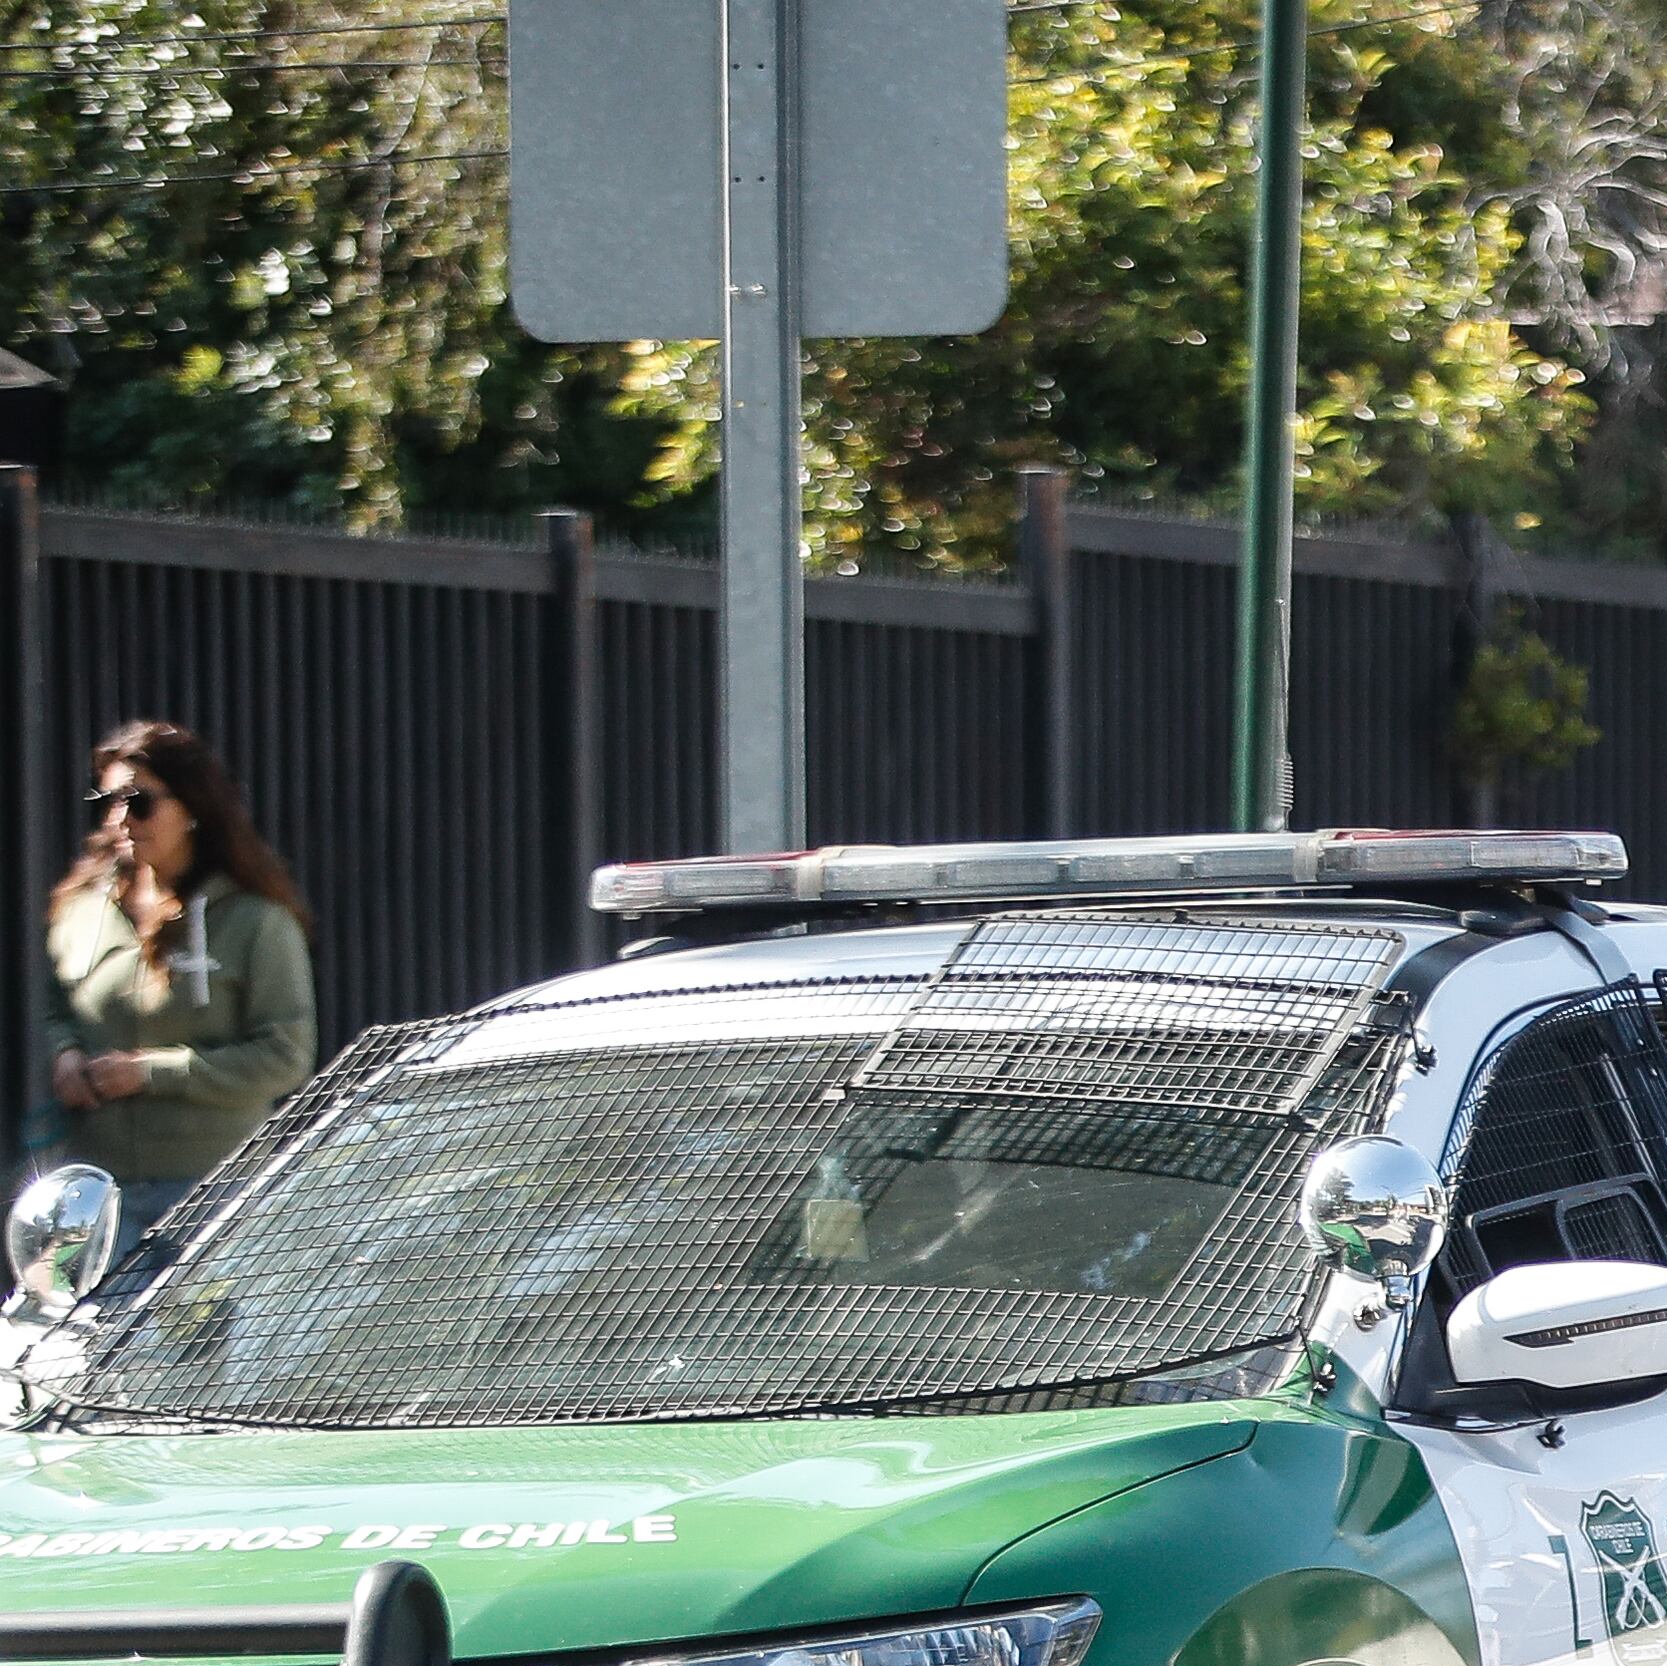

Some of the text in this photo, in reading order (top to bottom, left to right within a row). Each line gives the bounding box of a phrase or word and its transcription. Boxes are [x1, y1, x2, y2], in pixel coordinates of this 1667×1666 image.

[0, 1516, 677, 1558] ABINEROS DE CHILE
